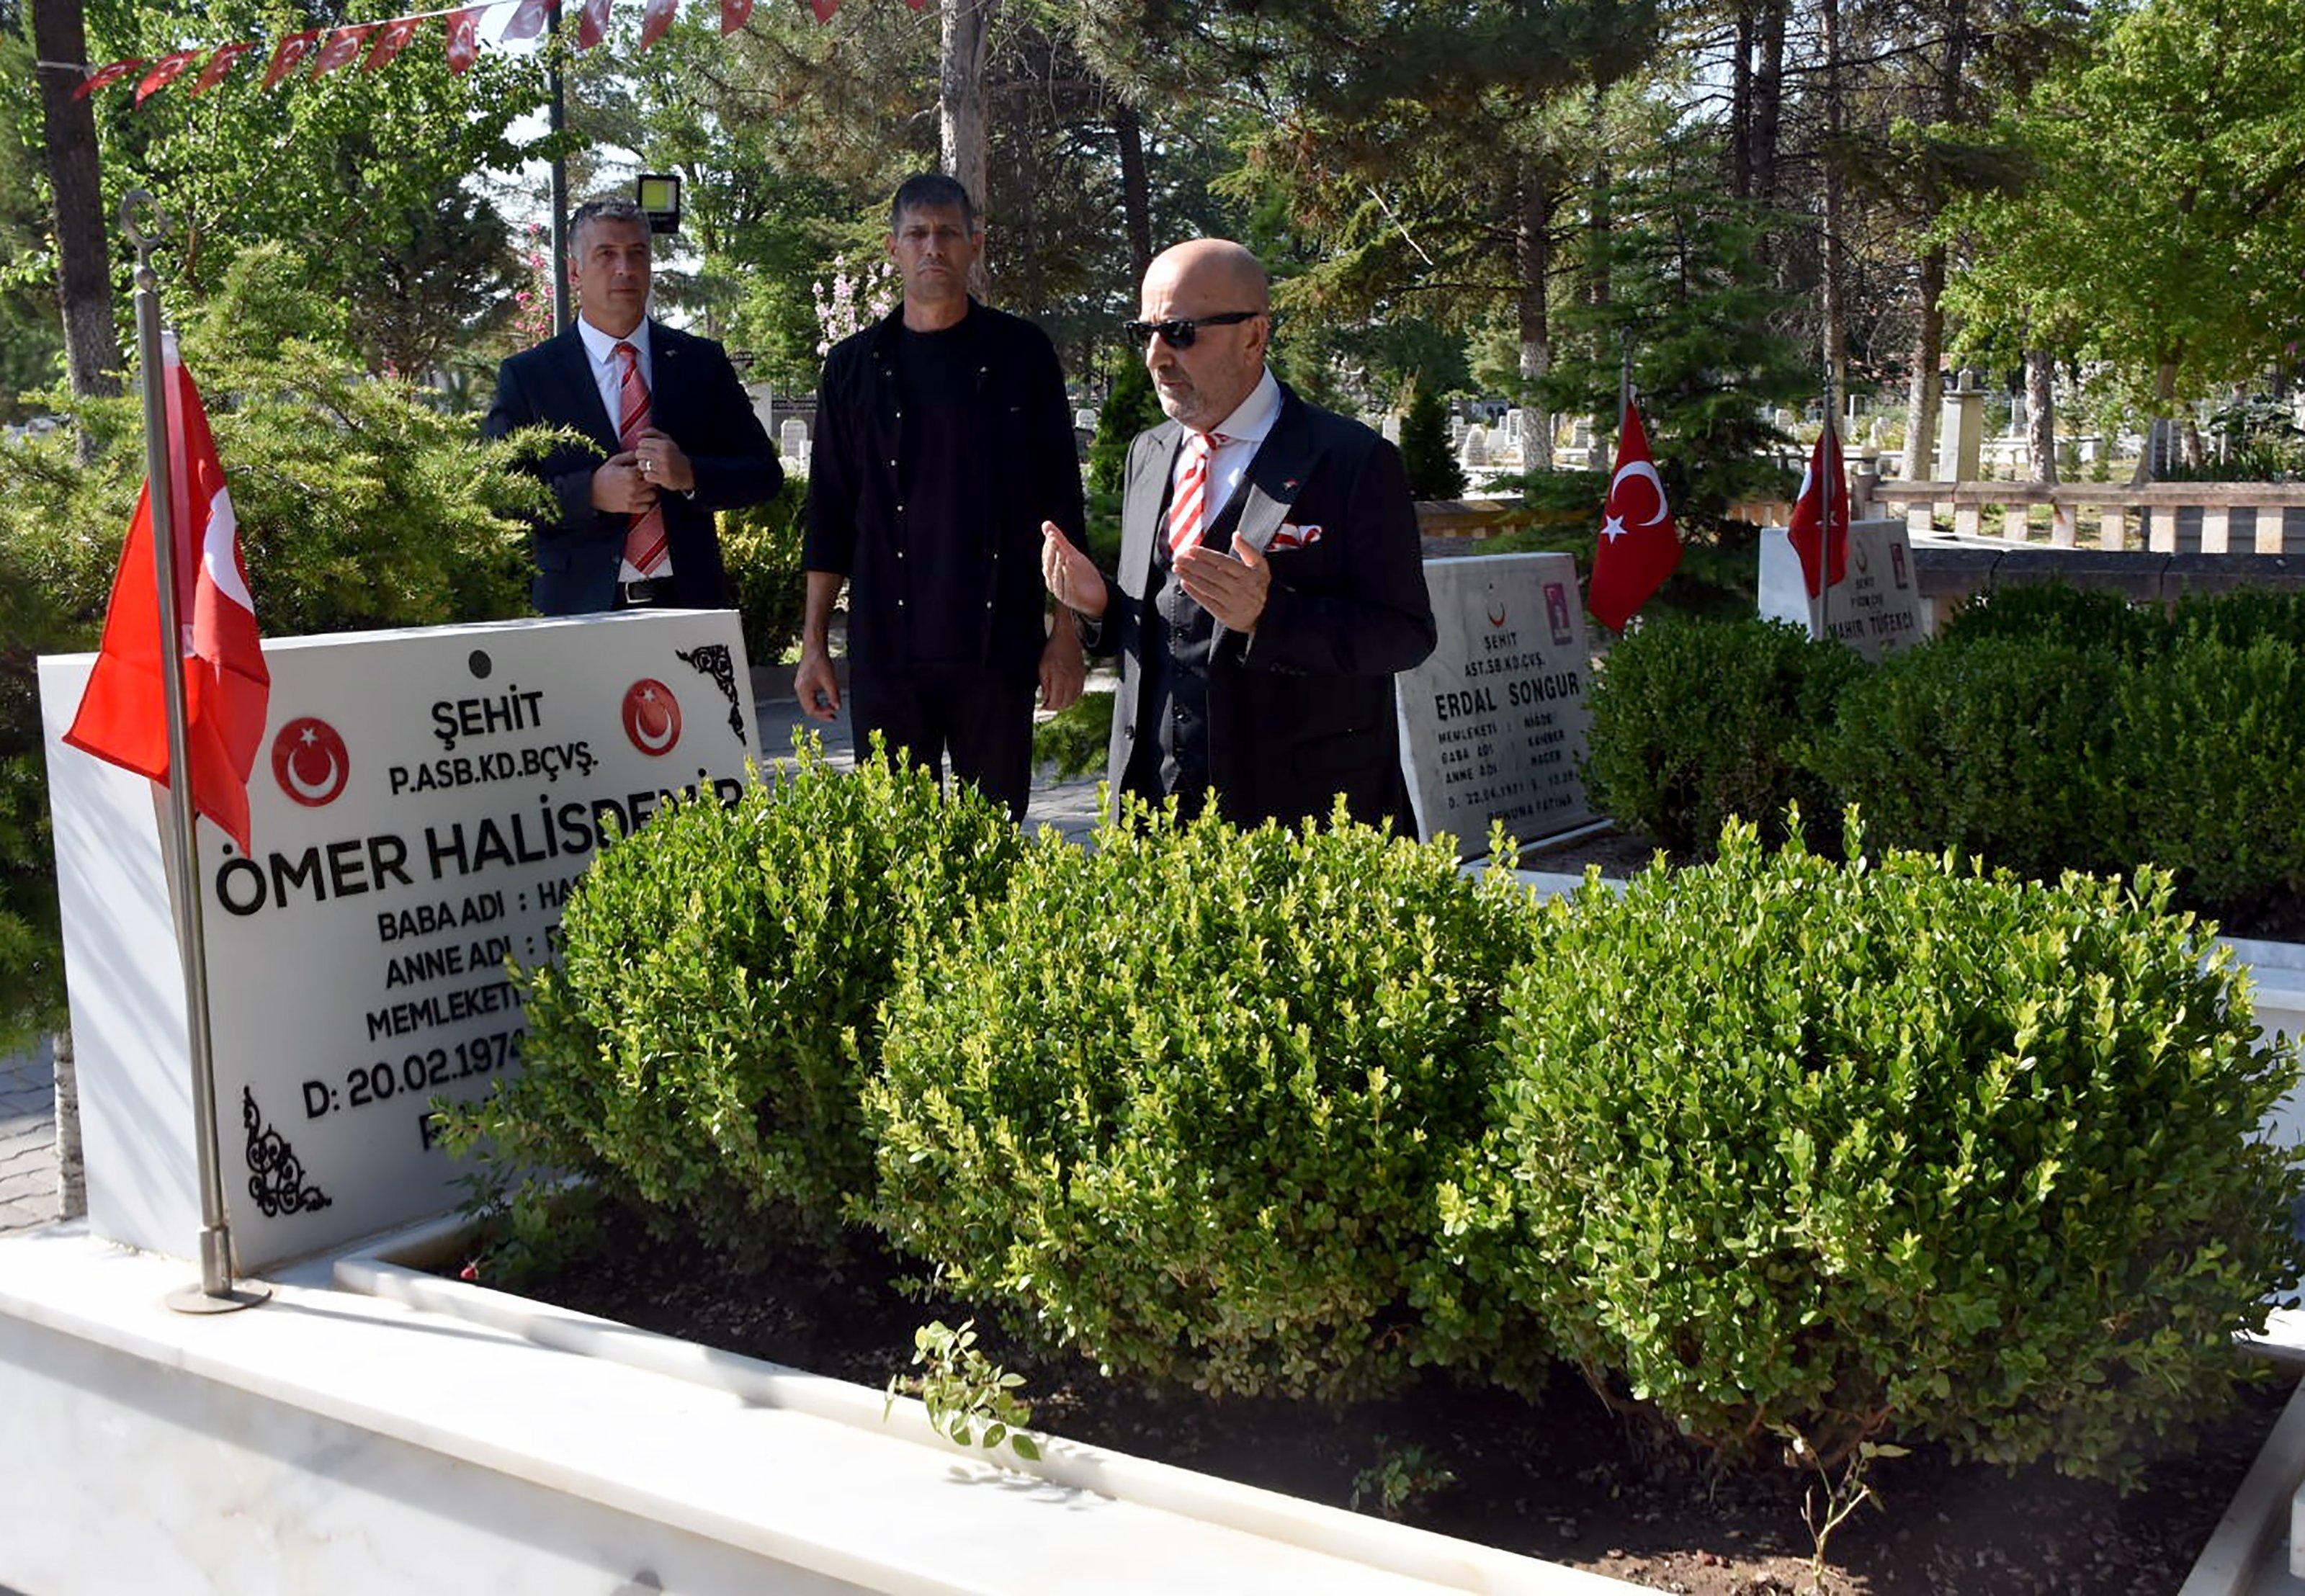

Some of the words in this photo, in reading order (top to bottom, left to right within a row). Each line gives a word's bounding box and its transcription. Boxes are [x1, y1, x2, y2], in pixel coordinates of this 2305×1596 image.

[1484, 630, 1516, 653] ŞEHİT
[432, 684, 543, 750] ŞEHİT
[1435, 687, 1497, 721] ERDAL
[1508, 672, 1580, 706] SONGUR
[389, 741, 599, 795] P.ASB.KD.BÇVŞ.
[215, 834, 413, 916] ÖMER
